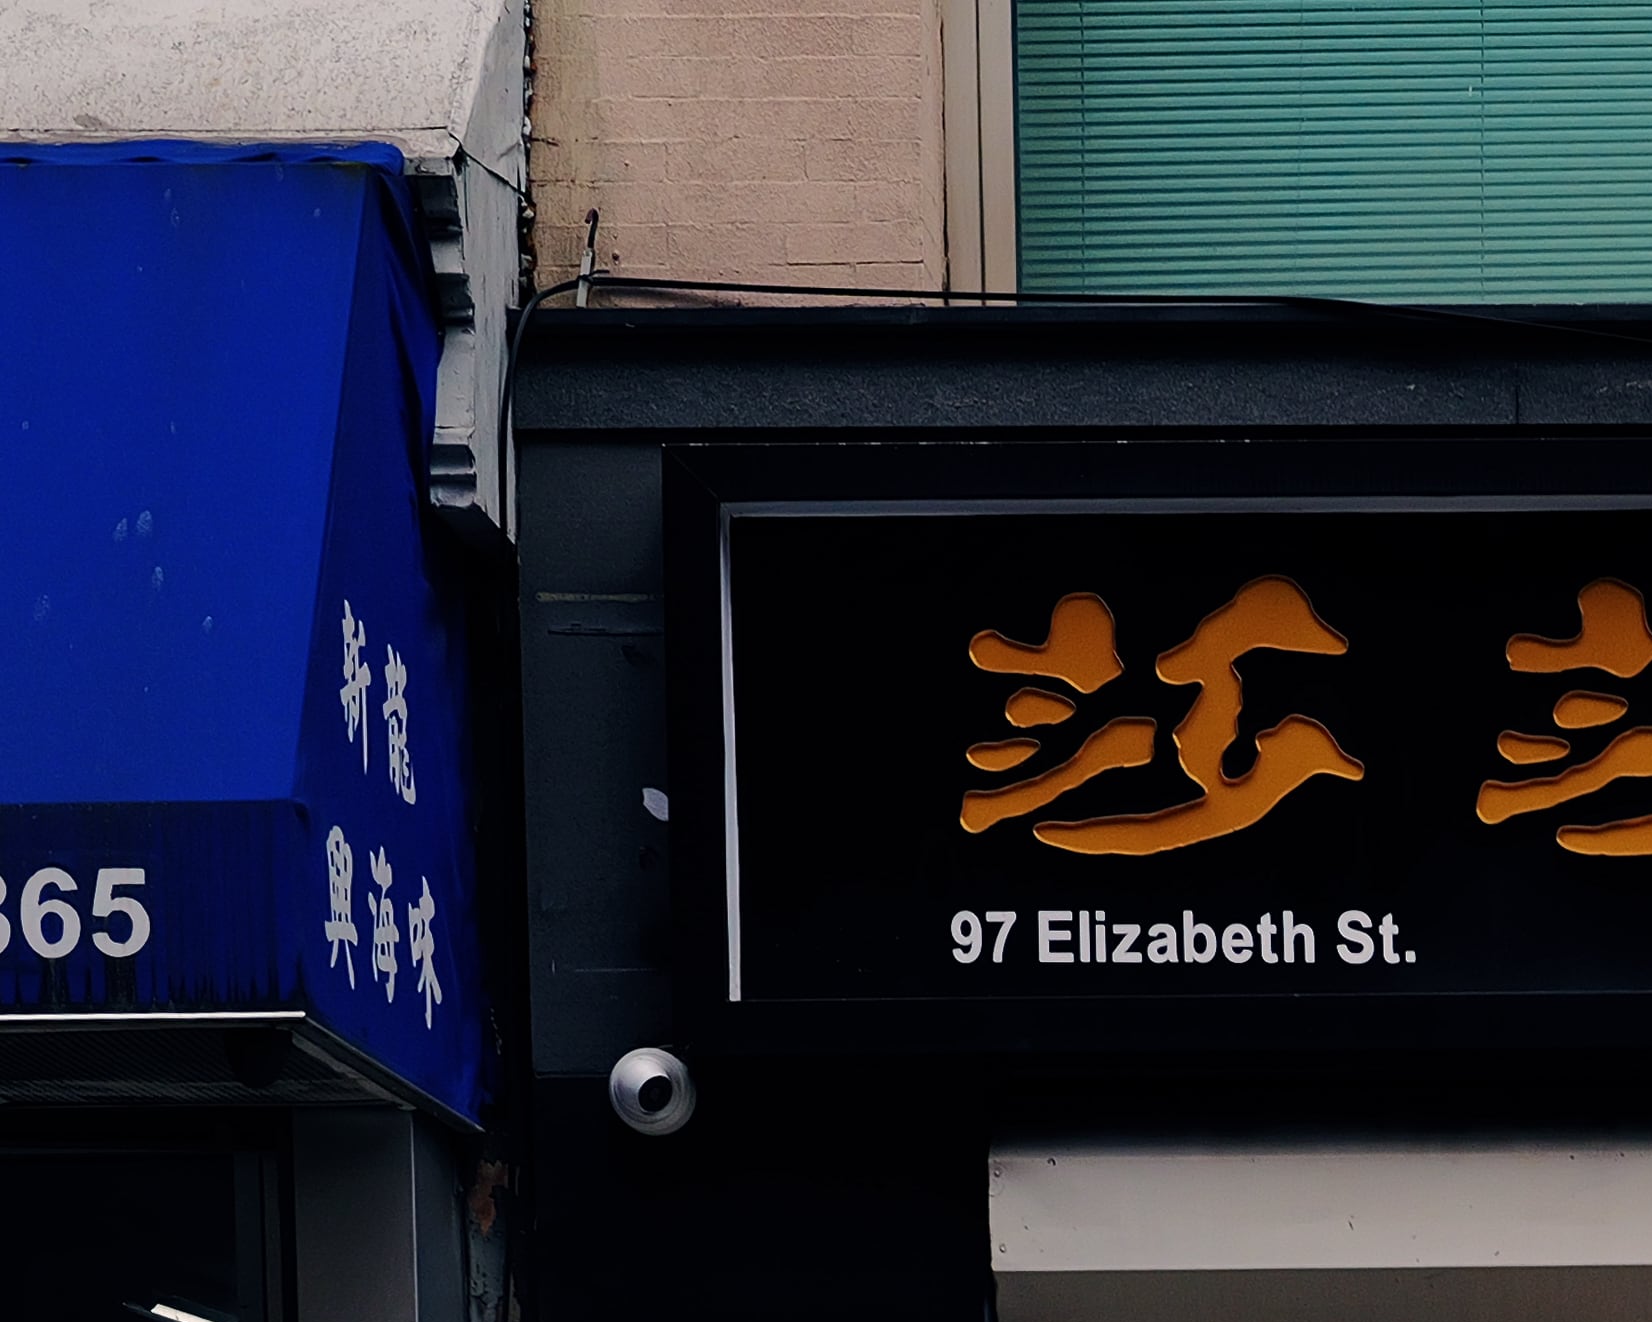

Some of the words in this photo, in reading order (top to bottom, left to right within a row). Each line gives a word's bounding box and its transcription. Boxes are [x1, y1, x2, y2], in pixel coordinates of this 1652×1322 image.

[0, 867, 151, 959] 65
[951, 911, 1016, 963] 97
[1038, 910, 1315, 963] Elizabeth
[1337, 910, 1416, 964] St.
